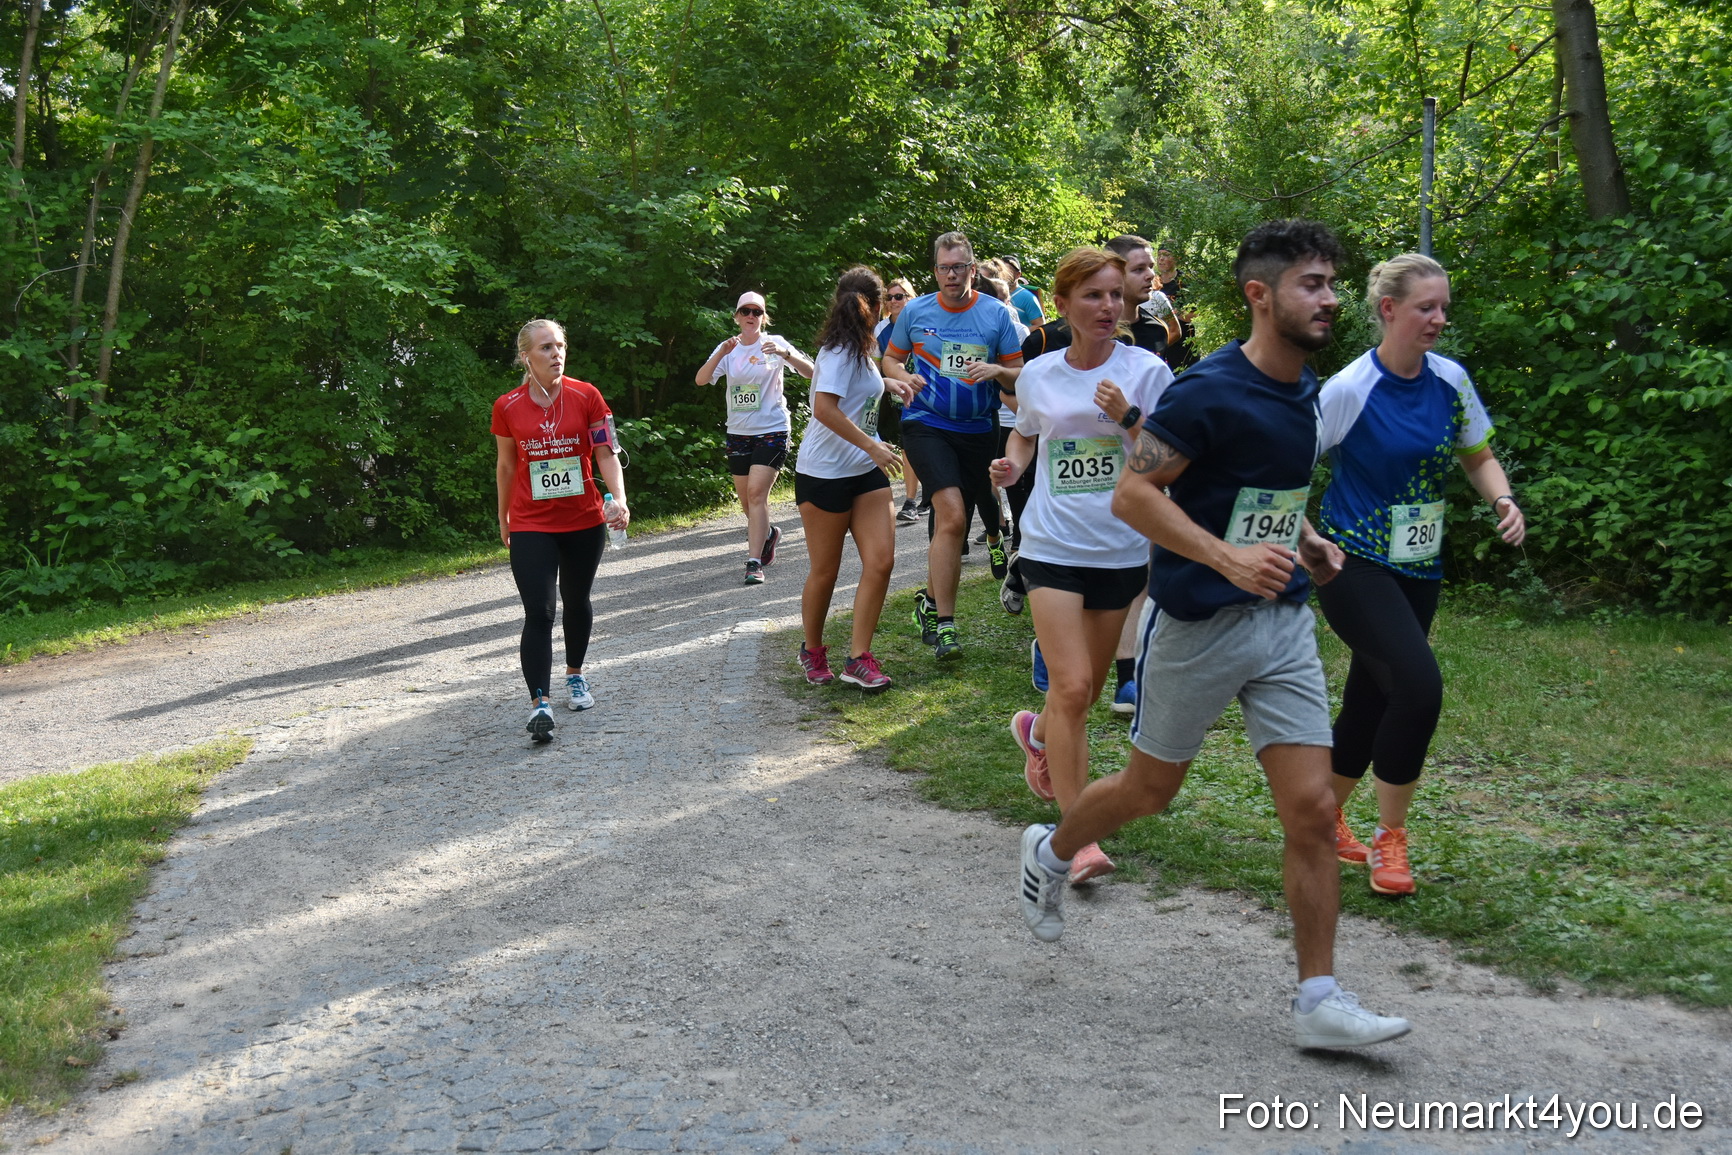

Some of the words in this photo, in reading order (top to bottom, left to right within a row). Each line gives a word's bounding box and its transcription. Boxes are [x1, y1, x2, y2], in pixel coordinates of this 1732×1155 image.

[733, 393, 756, 405] 1360
[550, 446, 573, 455] FRISCH
[1057, 456, 1114, 479] 2035
[541, 471, 572, 488] 604
[1242, 513, 1297, 539] 1948
[1405, 523, 1436, 546] 280
